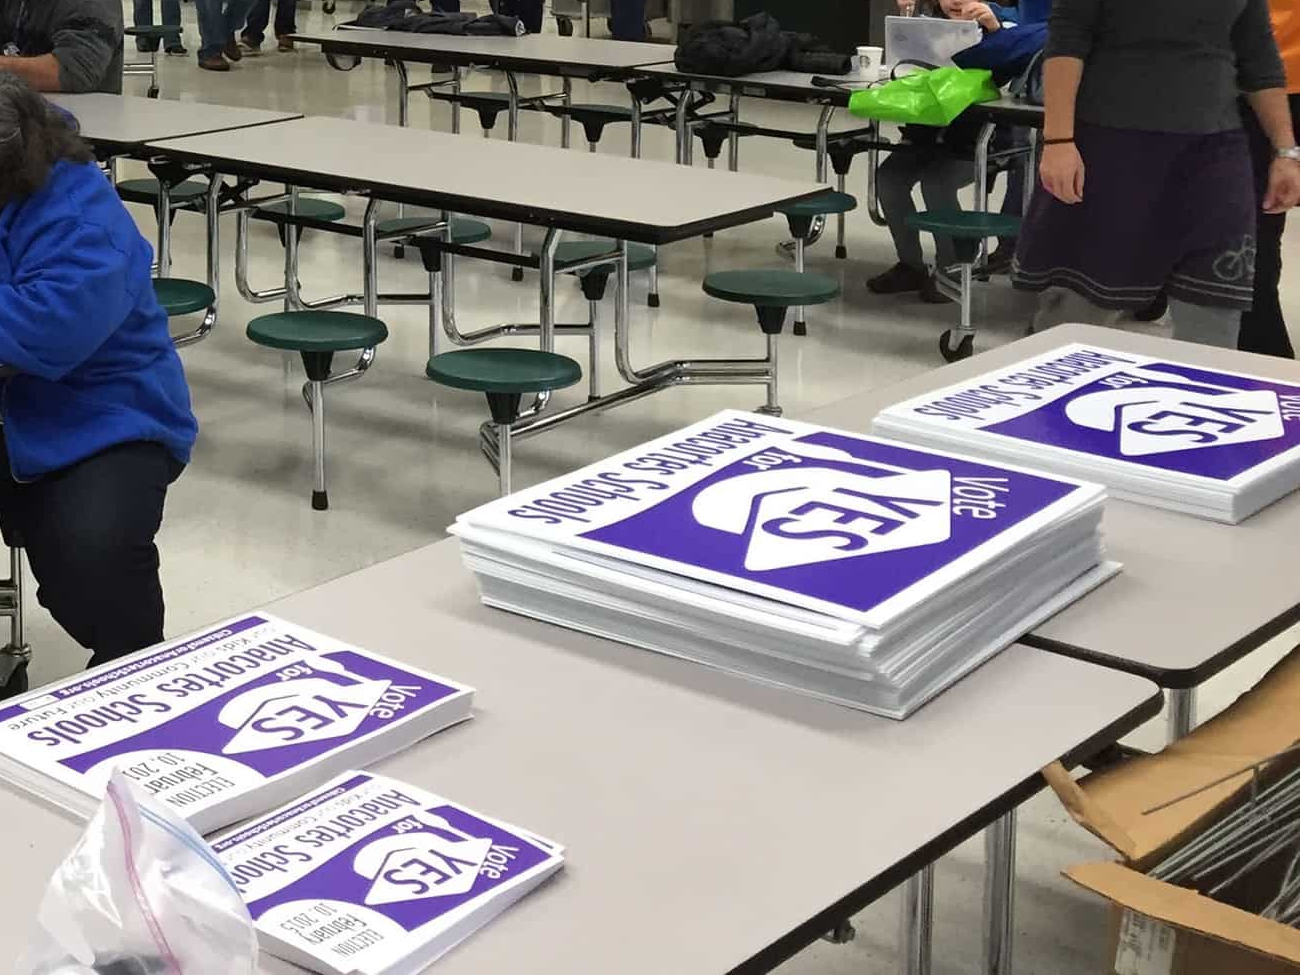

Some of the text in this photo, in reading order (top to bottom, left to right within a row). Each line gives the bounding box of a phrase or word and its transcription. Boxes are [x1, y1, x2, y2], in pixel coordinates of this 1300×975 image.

[913, 349, 1136, 421] Anacortes Schools
[1100, 372, 1149, 390] for
[1127, 401, 1275, 445] YES
[507, 418, 794, 525] Anacortes Schools
[742, 451, 802, 471] for
[951, 476, 1010, 521] Vote
[761, 487, 945, 552] YES
[97, 662, 191, 698] Community
[276, 661, 313, 681] for
[24, 634, 318, 748] Anacortes Schools
[369, 684, 423, 720] Vote
[10, 706, 68, 731] Future
[251, 695, 370, 741] YES
[121, 762, 160, 781] 201
[143, 762, 218, 794] Februar
[165, 776, 236, 808] ELECTION
[295, 788, 421, 847] Anacortes
[391, 816, 424, 834] for
[383, 849, 478, 895] YES
[479, 843, 520, 879] Vote
[280, 913, 320, 931] 2015
[291, 913, 368, 945] February
[330, 929, 385, 959] ELECTION
